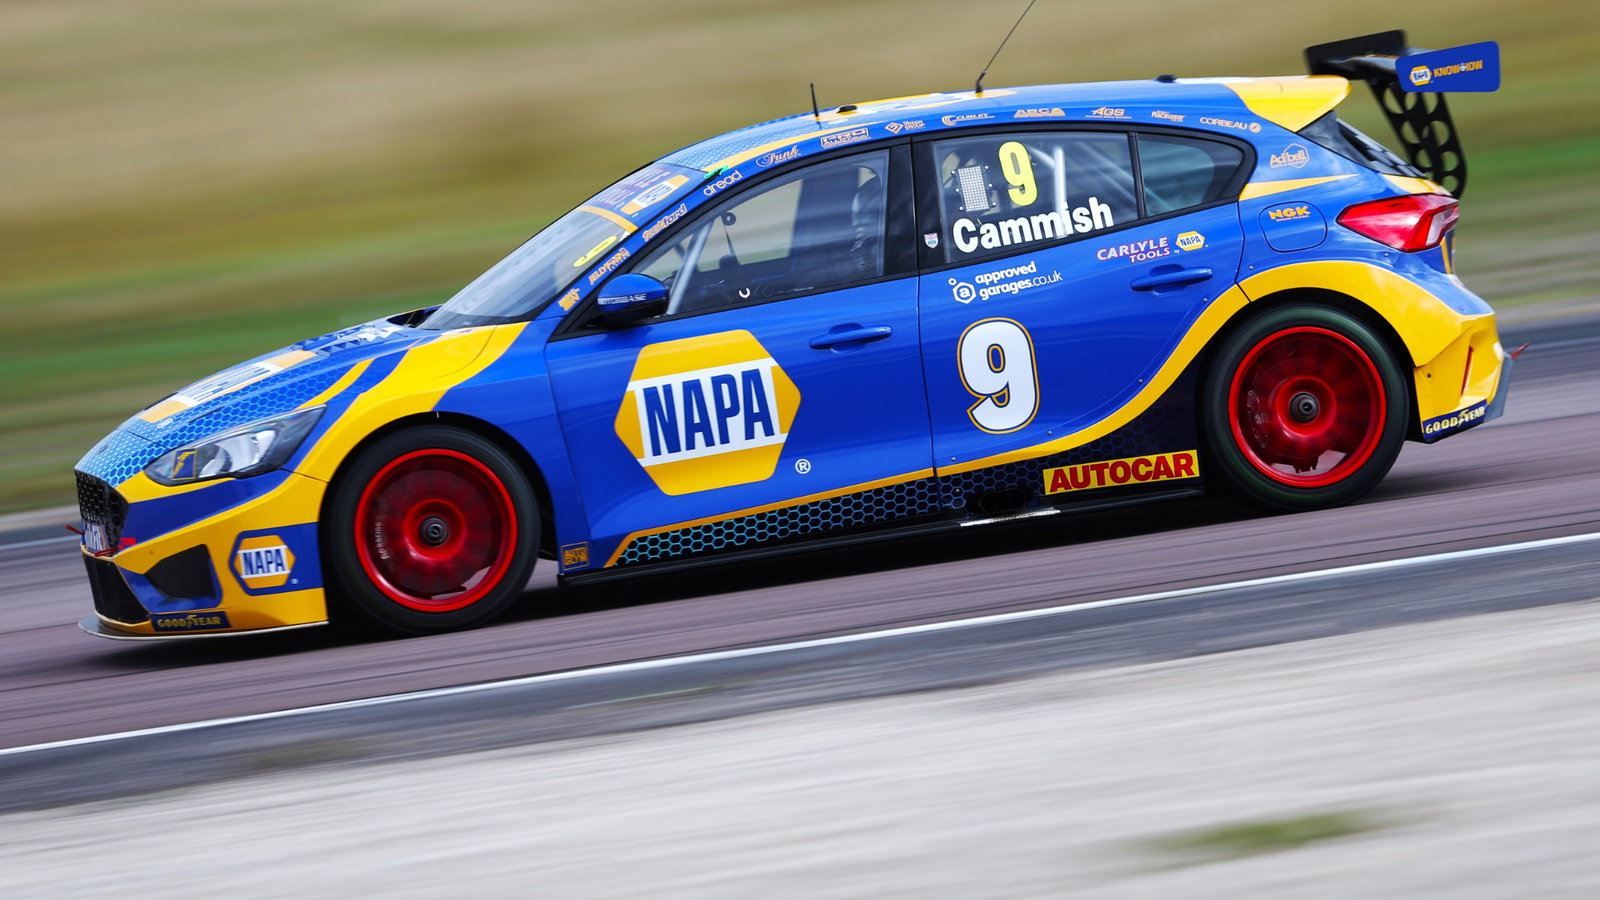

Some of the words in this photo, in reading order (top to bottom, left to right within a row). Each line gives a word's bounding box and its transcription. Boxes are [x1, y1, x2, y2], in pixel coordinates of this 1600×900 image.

[1200, 117, 1248, 130] CORBEAU
[703, 170, 743, 196] dread
[998, 141, 1038, 206] 9
[952, 196, 1114, 253] Cammish
[1268, 206, 1311, 220] NGK
[1097, 237, 1169, 261] CARLYLE
[1179, 234, 1202, 247] NAPA
[1129, 247, 1171, 264] TOOLS
[975, 260, 1038, 286] approved
[979, 270, 1064, 301] garages.co.uk
[957, 317, 1040, 435] 9
[643, 368, 776, 457] NAPA
[1425, 407, 1485, 435] GOODYEAR
[1049, 453, 1195, 492] AUTOCAR
[242, 547, 286, 576] NAPA
[157, 615, 221, 628] GOODYEAR
